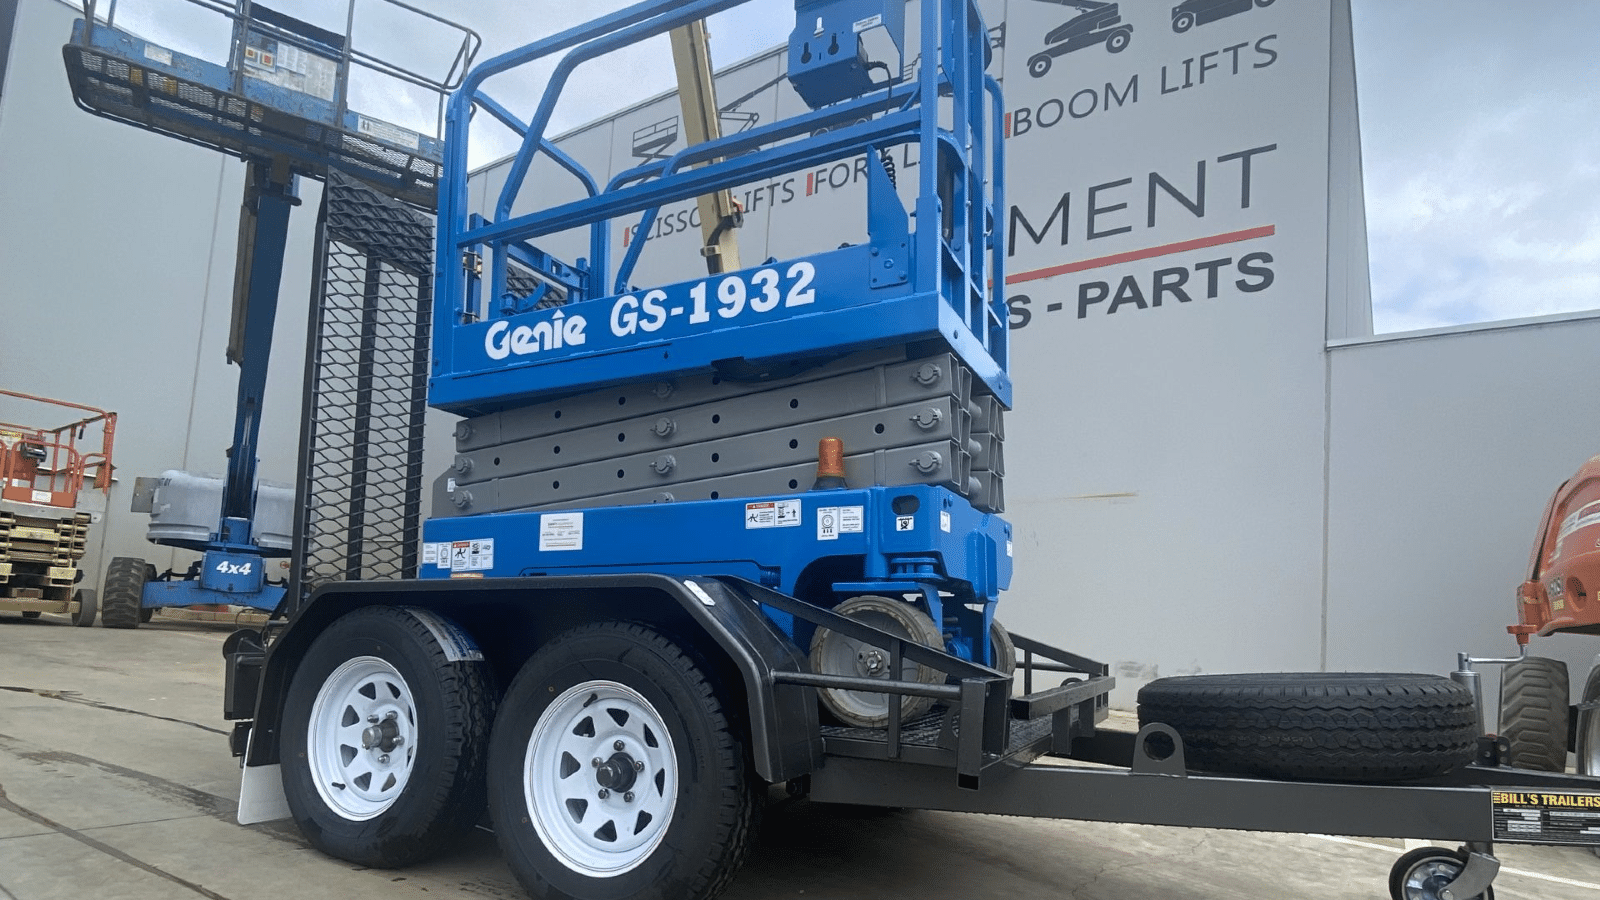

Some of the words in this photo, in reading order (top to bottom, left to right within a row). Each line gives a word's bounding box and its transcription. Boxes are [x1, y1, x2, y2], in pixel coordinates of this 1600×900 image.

[1013, 74, 1139, 137] BOOM
[1161, 34, 1277, 95] LIFTS
[733, 178, 795, 214] IFTS
[485, 309, 587, 360] Genie
[610, 261, 816, 337] GS-1932
[1077, 252, 1275, 319] PARTS
[216, 561, 252, 575] 4x4
[1500, 793, 1538, 805] BILL'S
[1541, 795, 1600, 807] TRAILERS
